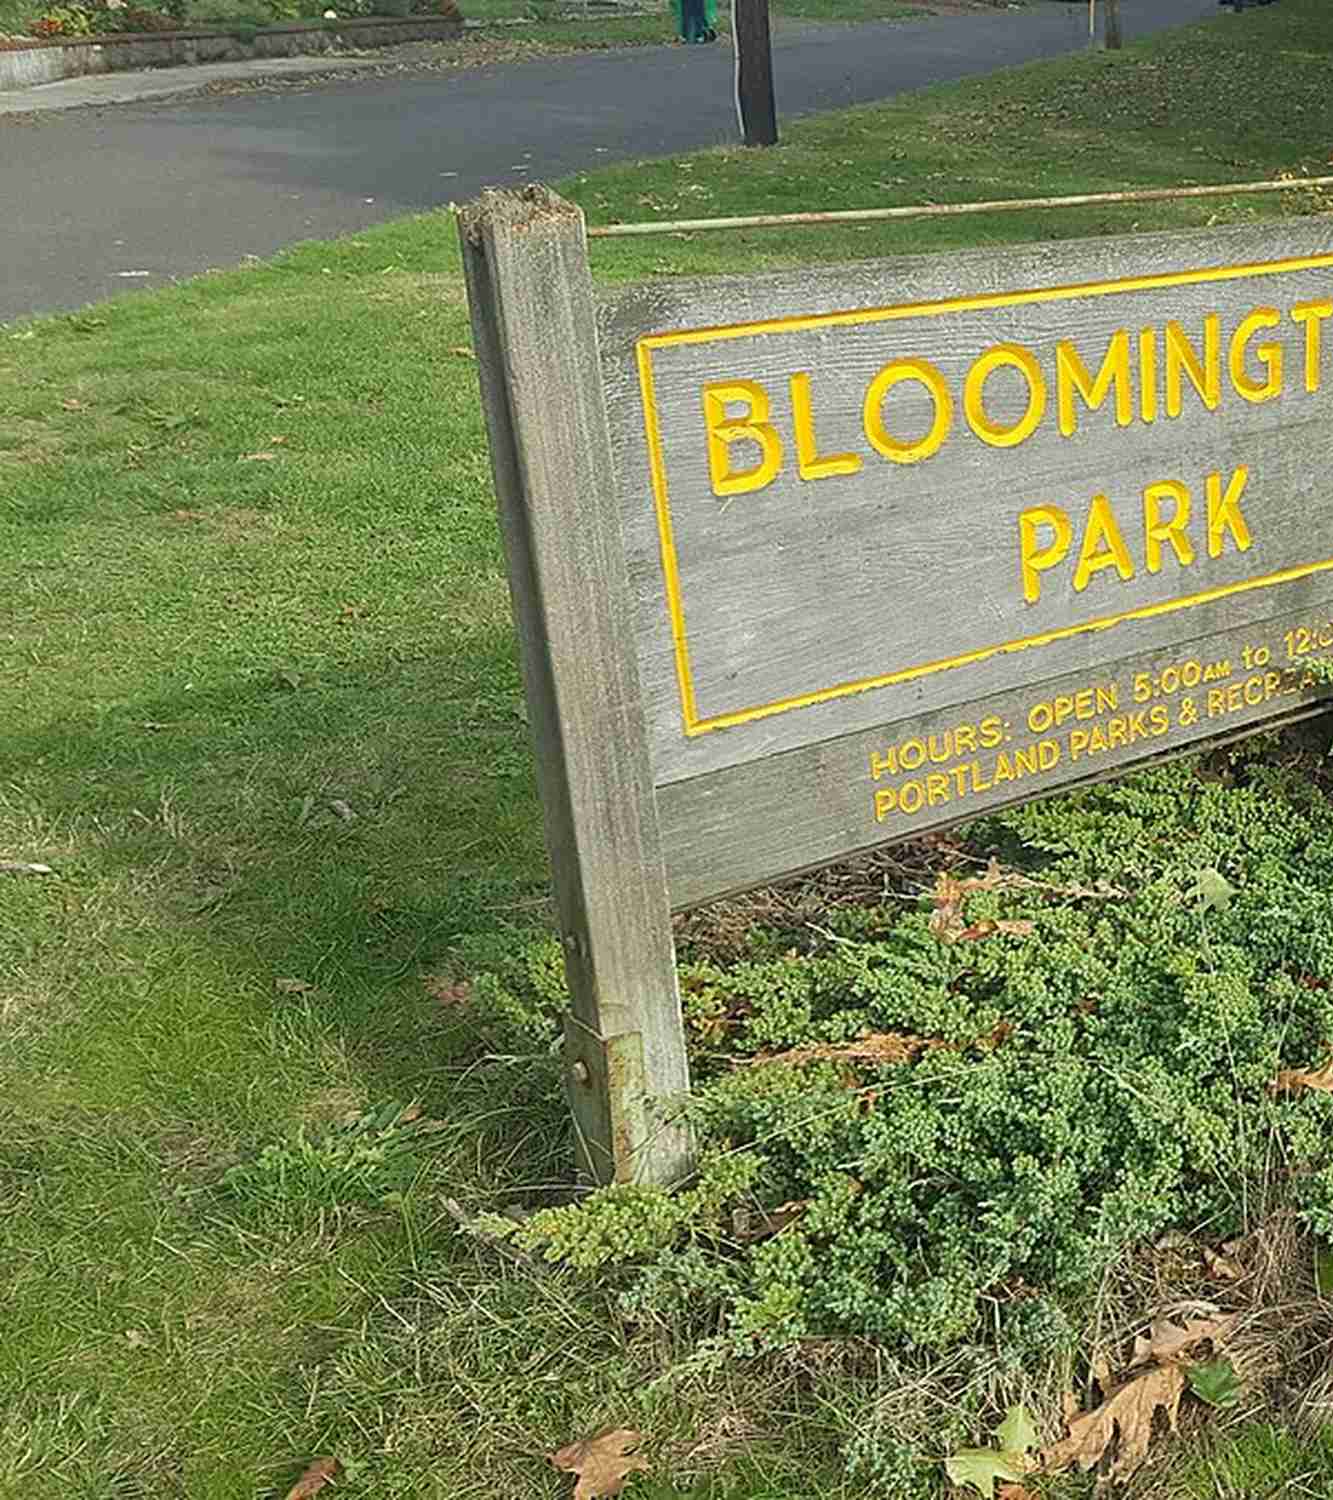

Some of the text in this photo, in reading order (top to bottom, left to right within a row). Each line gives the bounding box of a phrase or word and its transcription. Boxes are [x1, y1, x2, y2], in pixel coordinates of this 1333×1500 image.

[1018, 465, 1251, 603] PARK
[869, 715, 1011, 781] HOURS:
[1027, 684, 1118, 735] OPEN
[1242, 644, 1270, 671] to
[873, 739, 1060, 823] PORTLAND
[1069, 707, 1169, 760] PARKS
[1177, 697, 1200, 724] &
